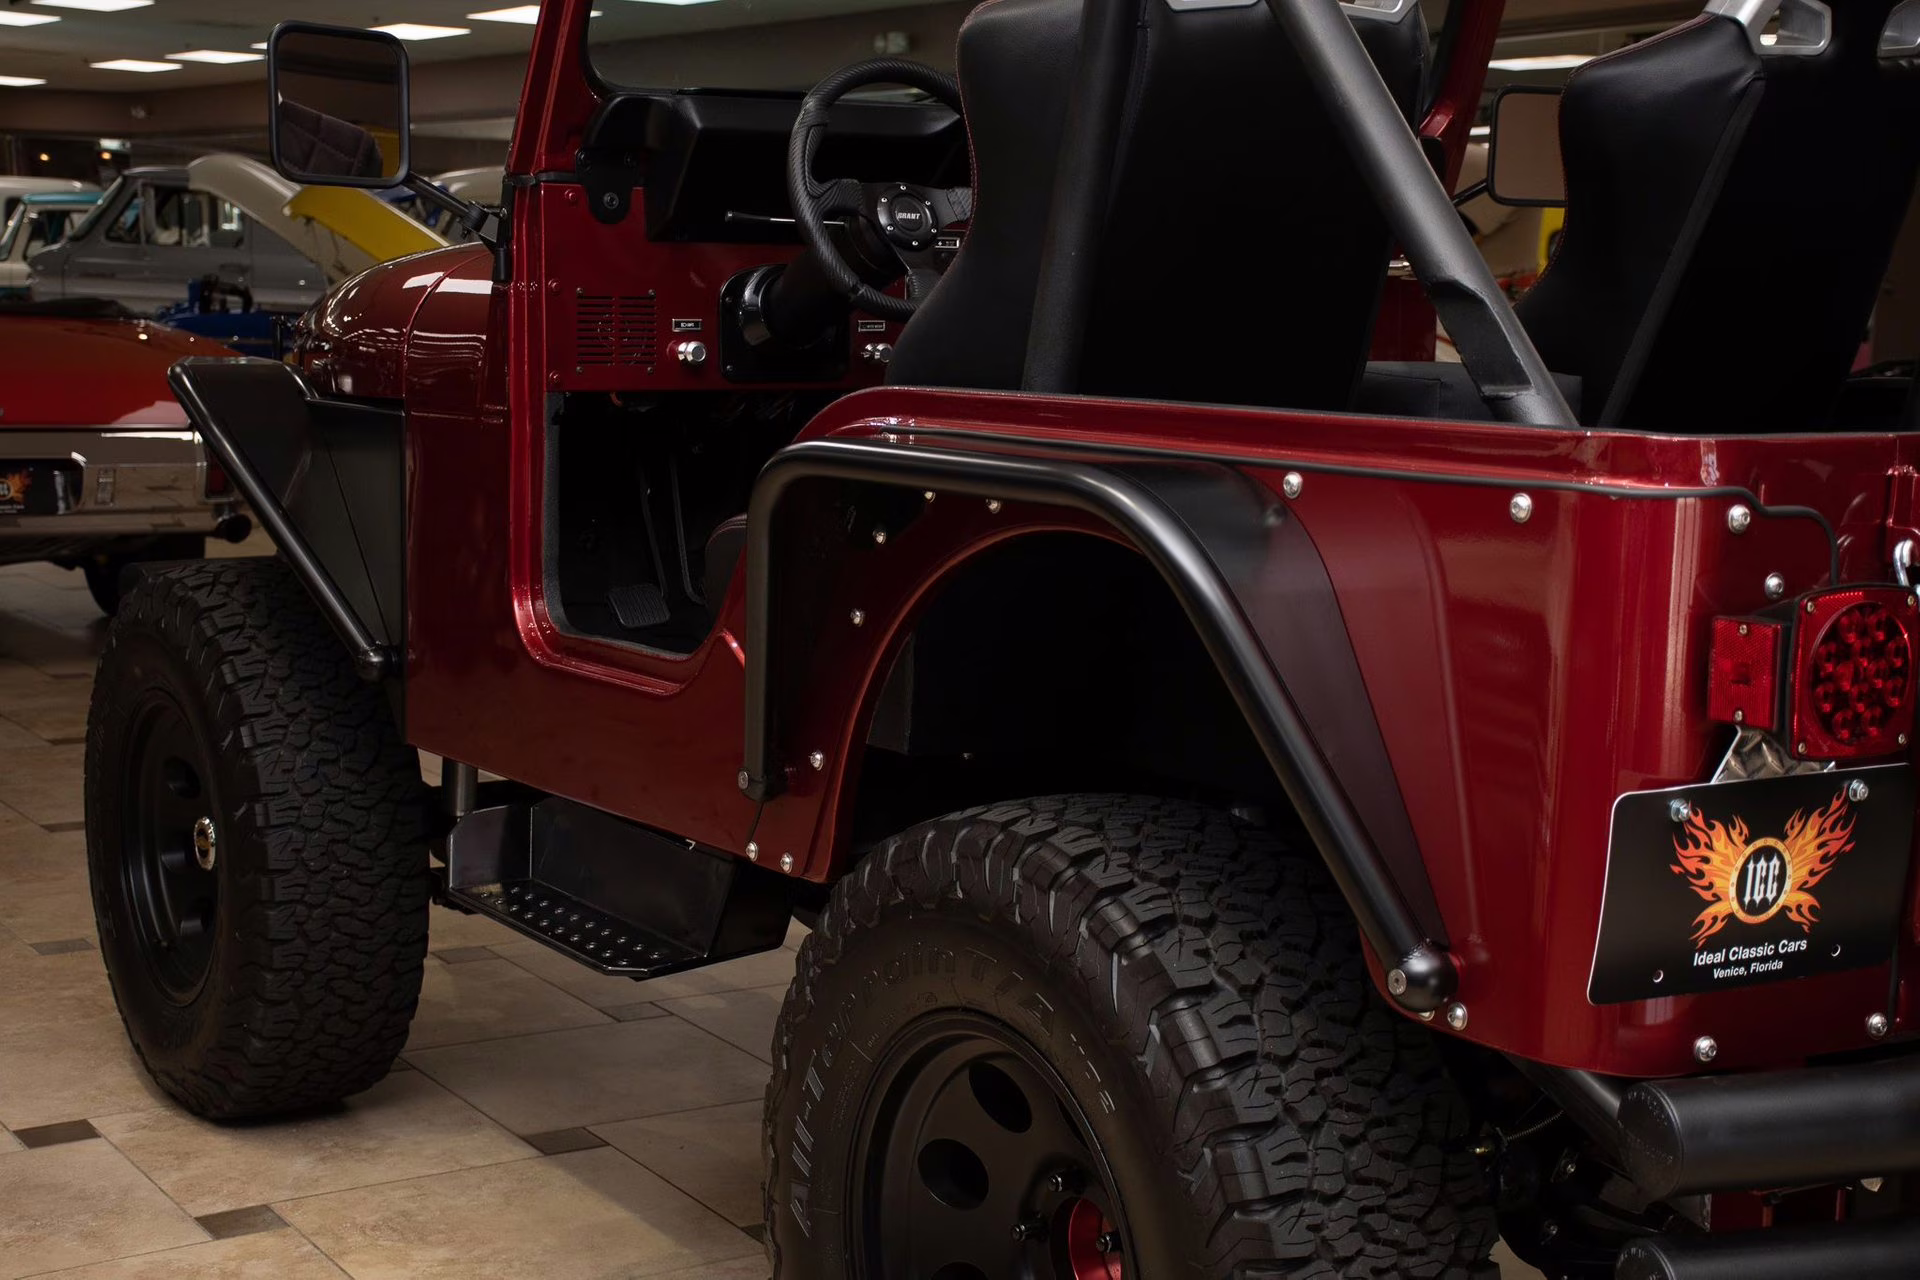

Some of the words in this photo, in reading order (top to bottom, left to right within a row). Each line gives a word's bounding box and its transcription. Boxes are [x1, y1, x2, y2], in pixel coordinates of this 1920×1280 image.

[896, 212, 921, 220] GRANT
[1744, 853, 1781, 911] ICC
[1693, 949, 1726, 967] Ideal
[1728, 942, 1775, 962] Classic
[1778, 939, 1808, 955] Cars
[1713, 966, 1748, 980] Venice,
[1750, 960, 1784, 974] Florida
